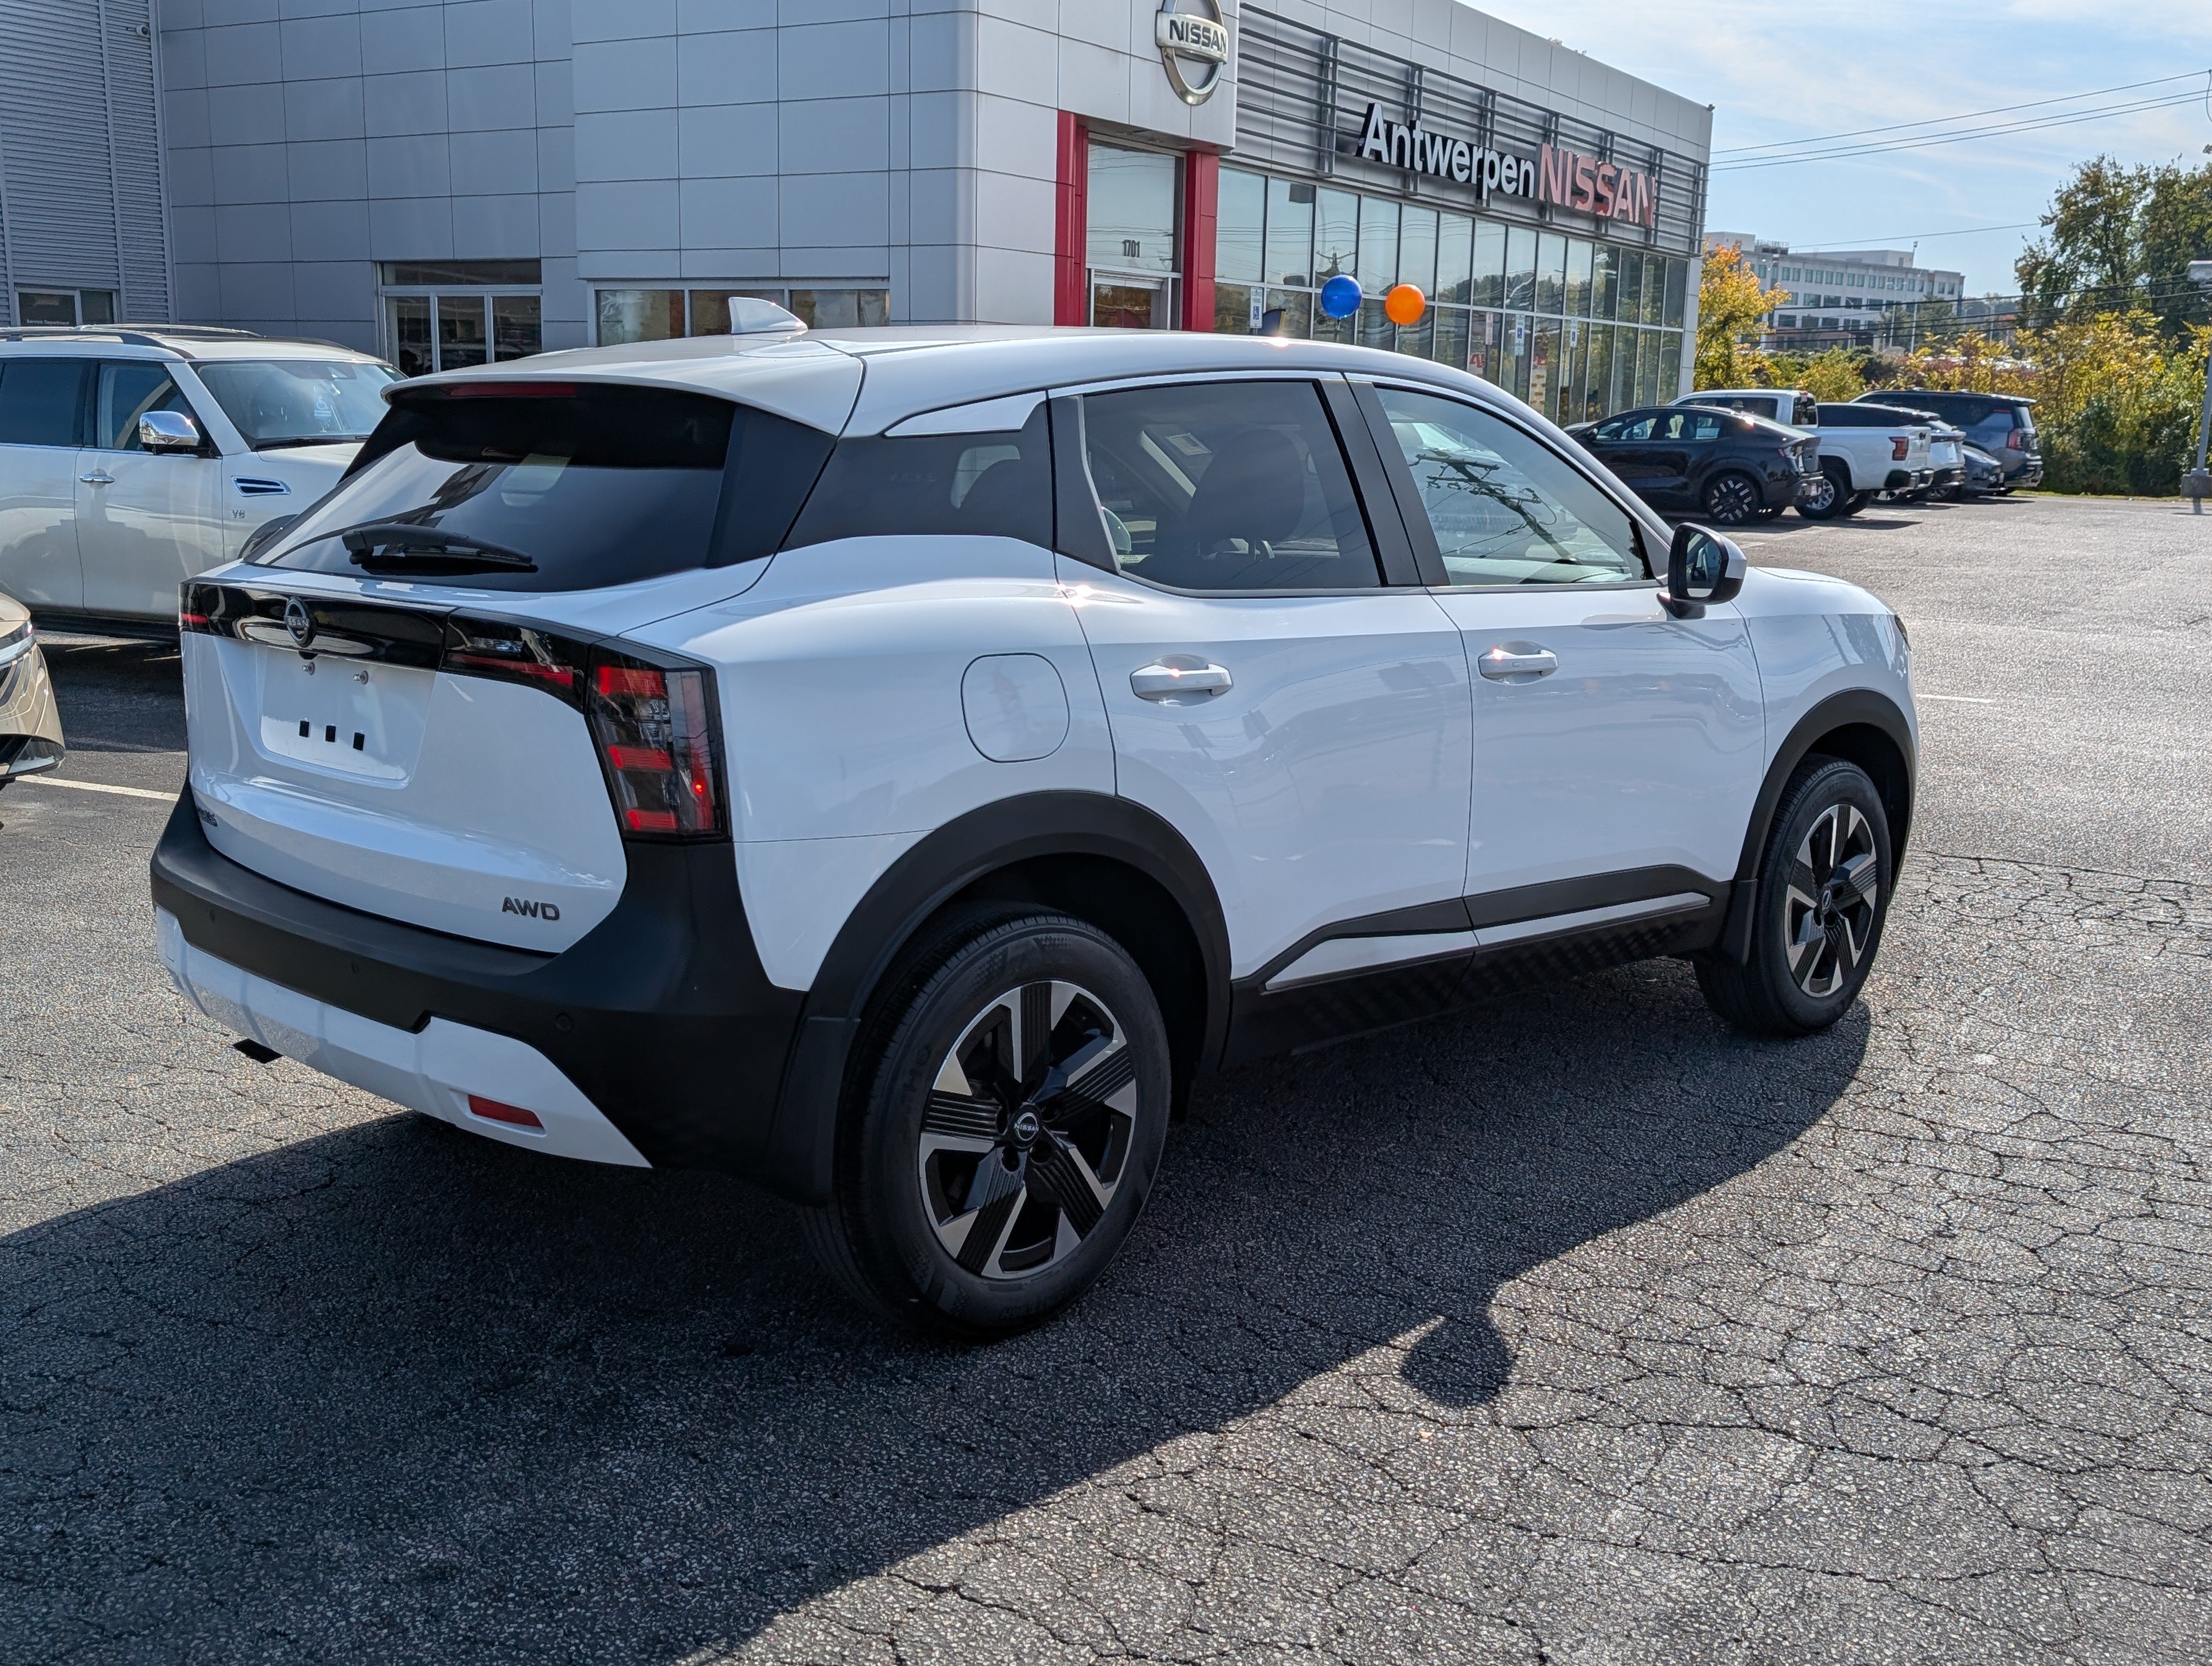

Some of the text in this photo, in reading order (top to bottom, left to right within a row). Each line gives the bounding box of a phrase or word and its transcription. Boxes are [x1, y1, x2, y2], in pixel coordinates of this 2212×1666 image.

[1169, 18, 1227, 54] NISSAN
[1358, 102, 1656, 227] Antwerpen NISSAN
[1122, 239, 1140, 258] 1701
[501, 896, 560, 921] AWD
[1013, 1123, 1039, 1132] NISSAN
